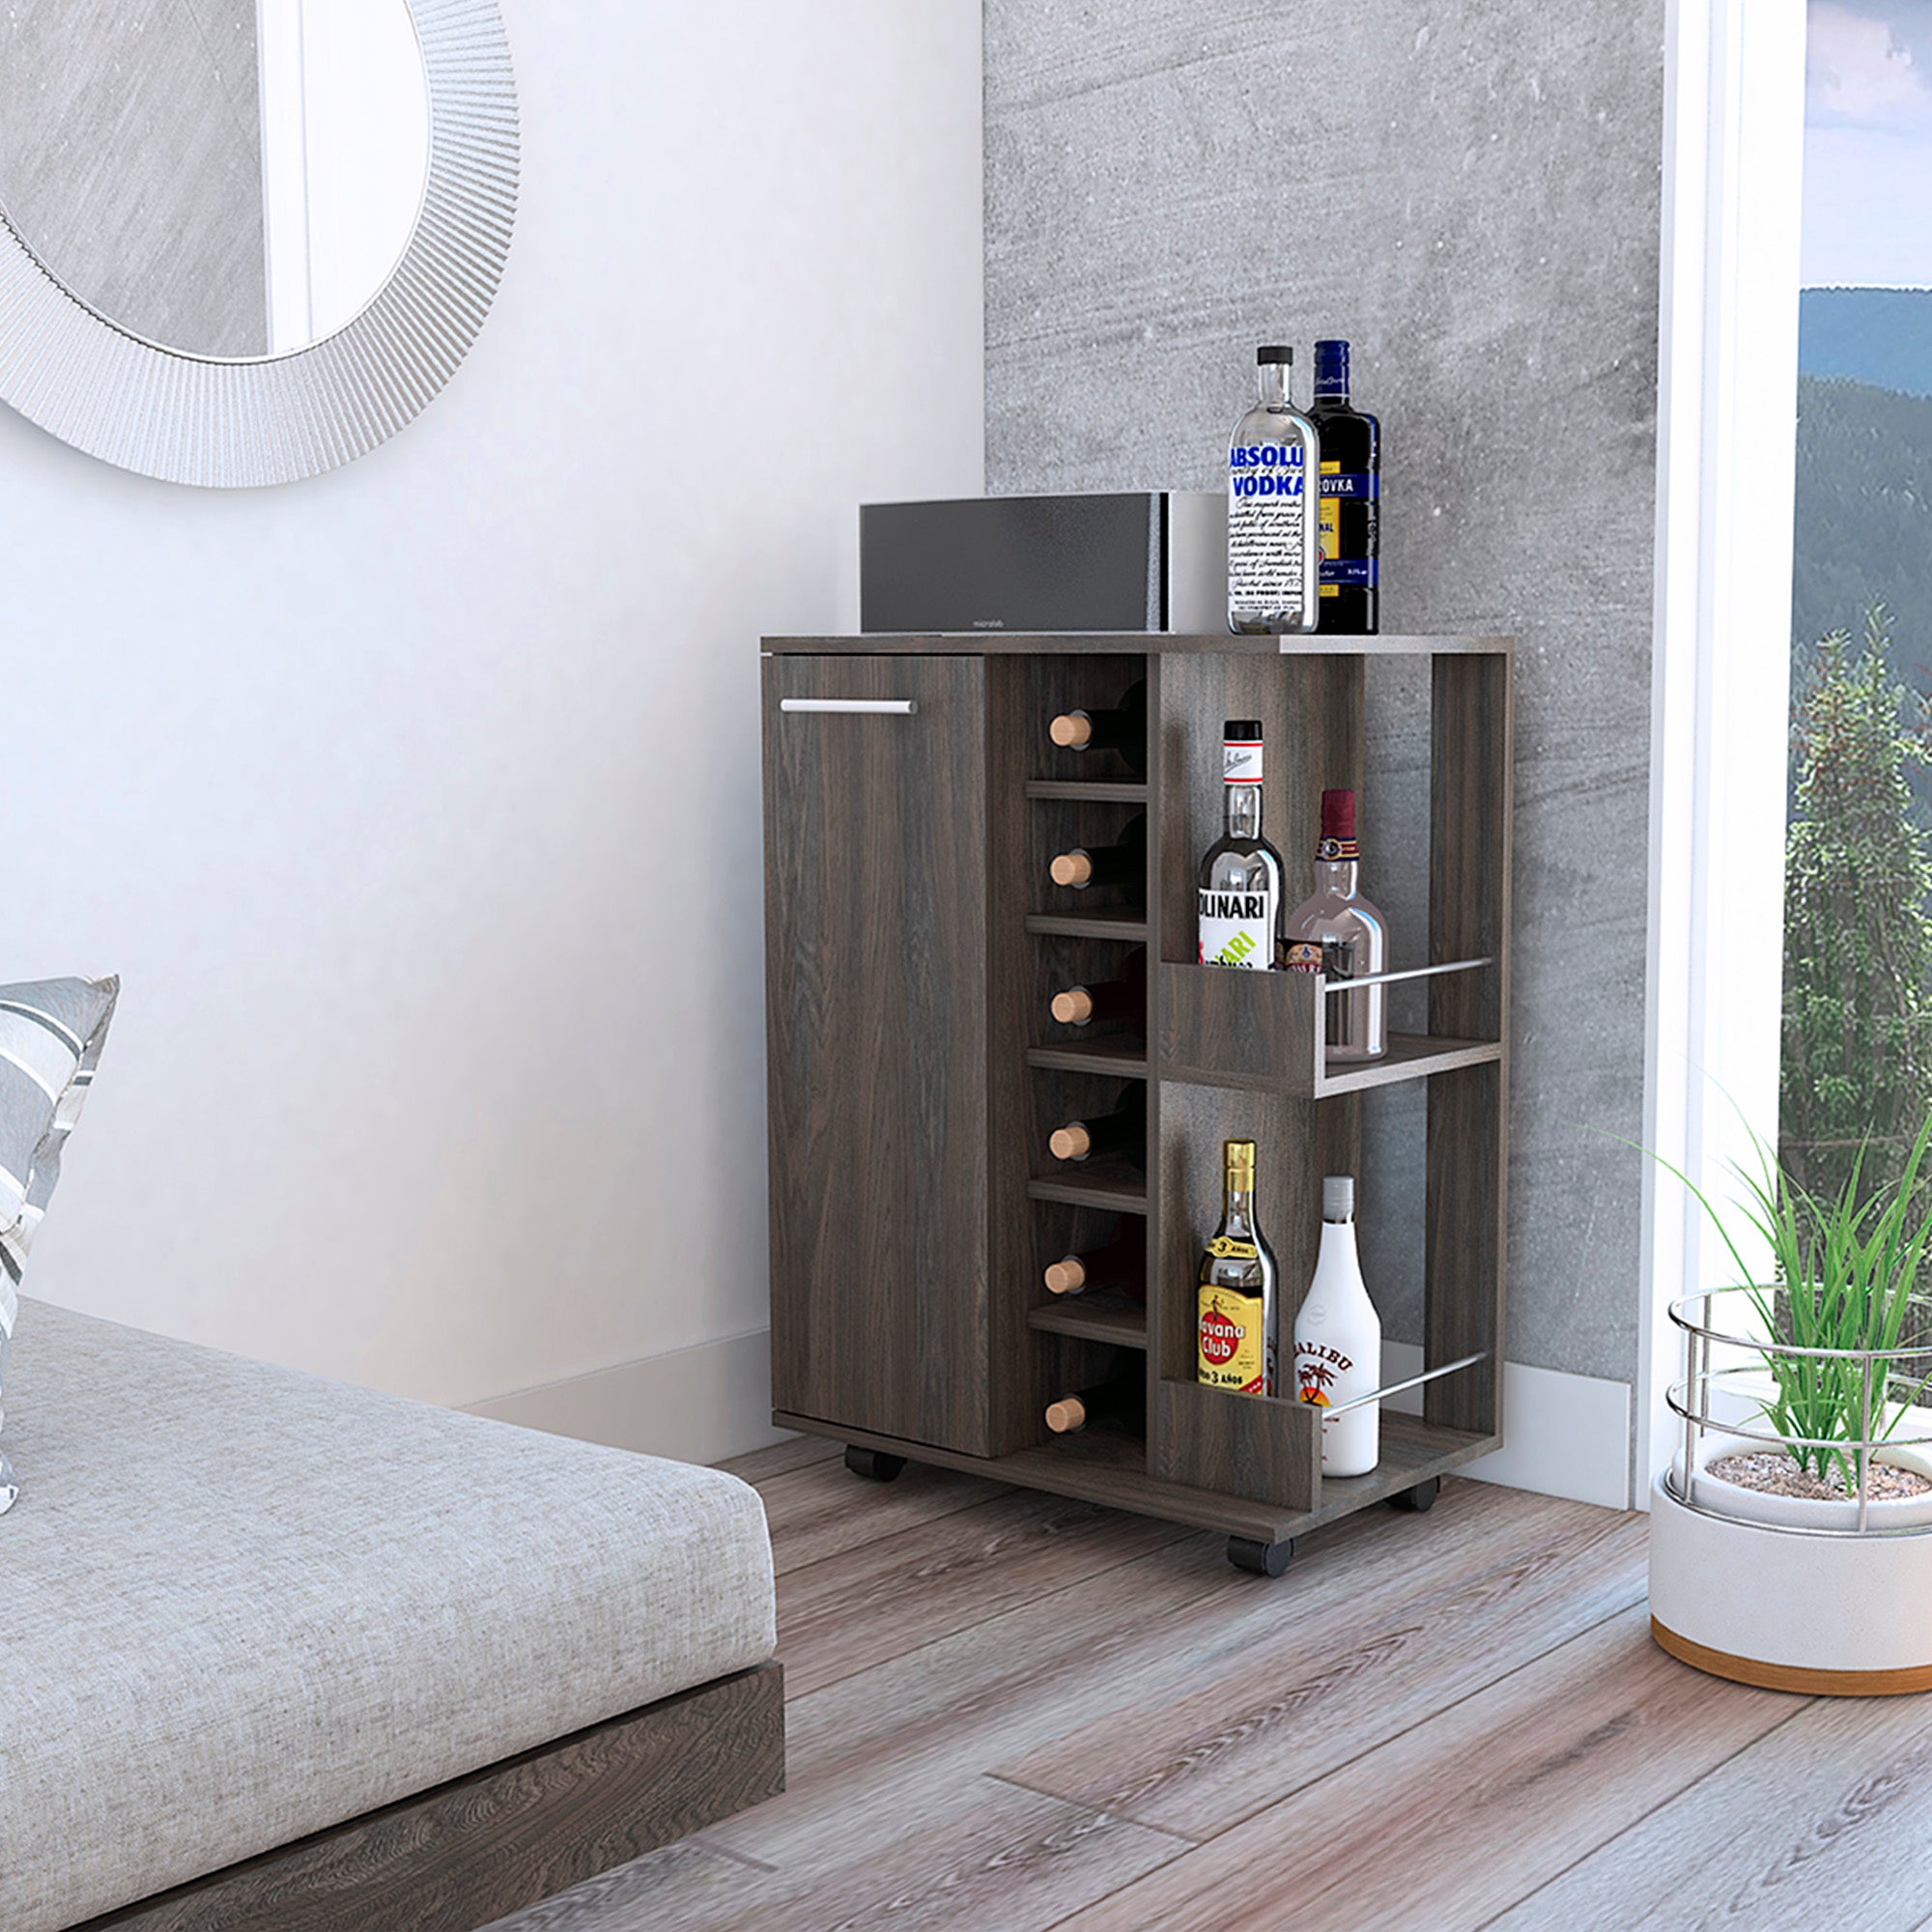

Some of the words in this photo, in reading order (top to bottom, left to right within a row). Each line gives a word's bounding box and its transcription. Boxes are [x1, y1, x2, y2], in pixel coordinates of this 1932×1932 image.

[1233, 475, 1303, 497] VODKA
[1319, 478, 1353, 493] OVKA
[1215, 930, 1257, 963] ARI
[1201, 1318, 1245, 1339] avana
[1203, 1336, 1232, 1357] Club
[1294, 1341, 1353, 1372] ALIBU
[1210, 1370, 1219, 1384] 3
